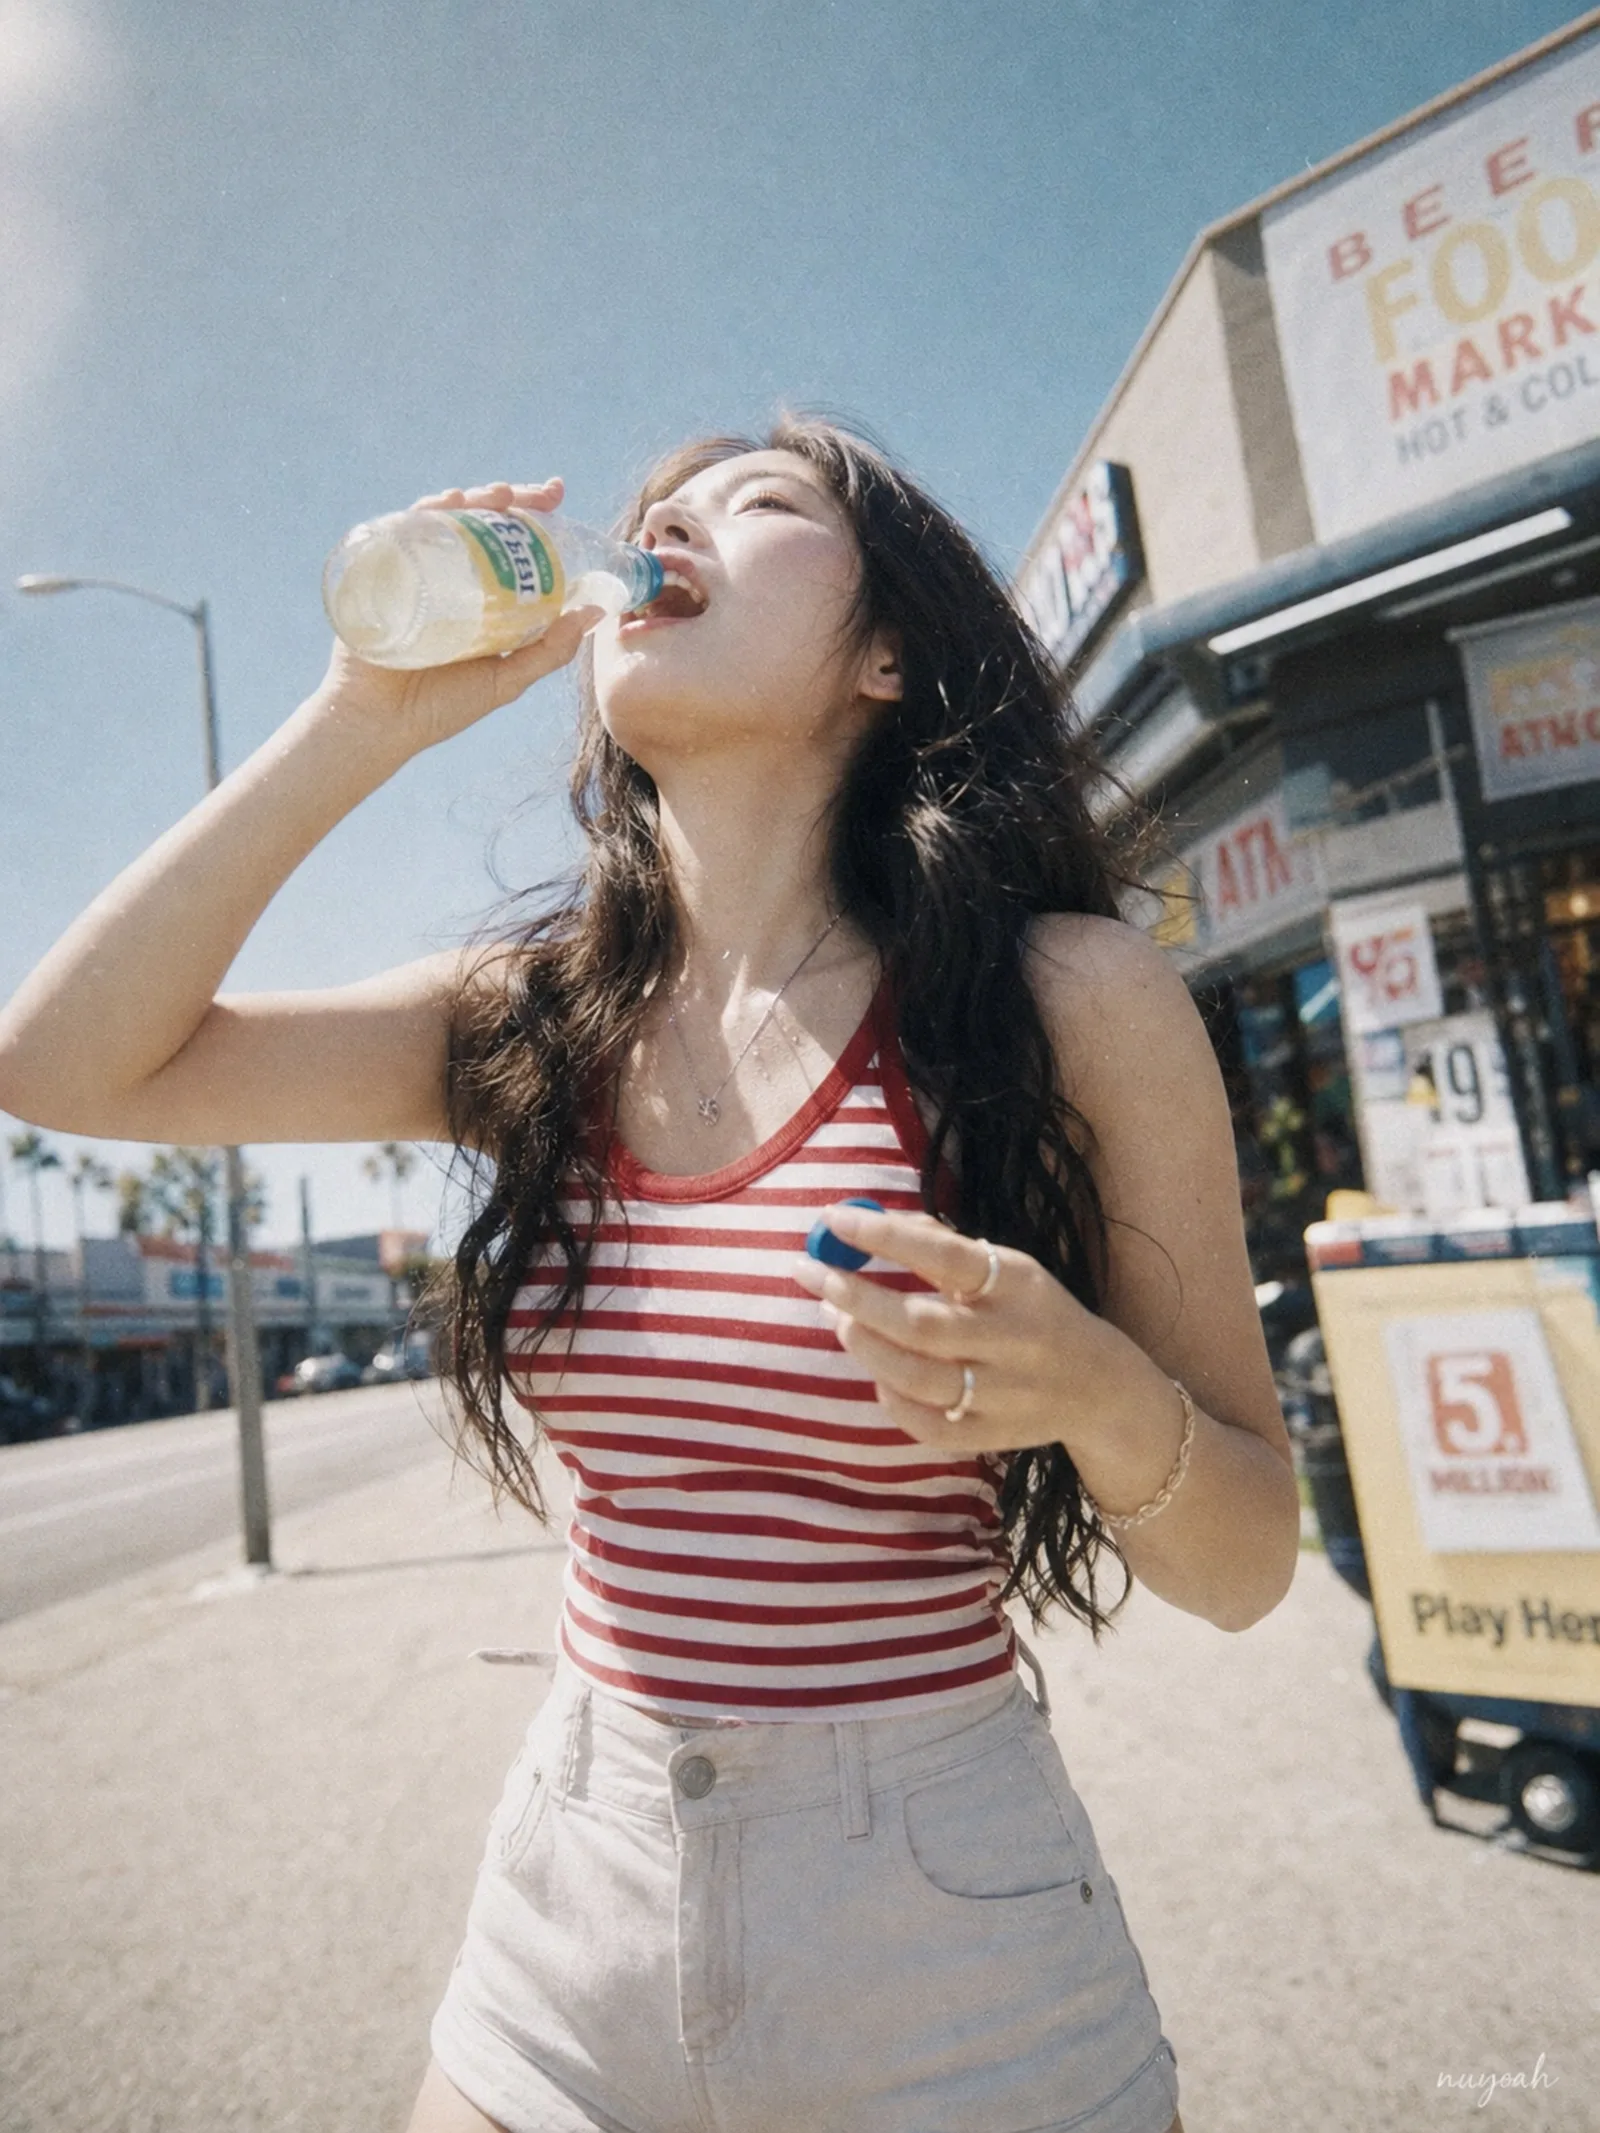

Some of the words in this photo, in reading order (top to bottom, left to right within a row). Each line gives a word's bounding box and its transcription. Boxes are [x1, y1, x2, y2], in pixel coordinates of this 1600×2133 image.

[1388, 284, 1598, 422] MARK
[1397, 408, 1469, 463] HOT
[1482, 393, 1509, 428] &
[1411, 1592, 1508, 1649] Play
